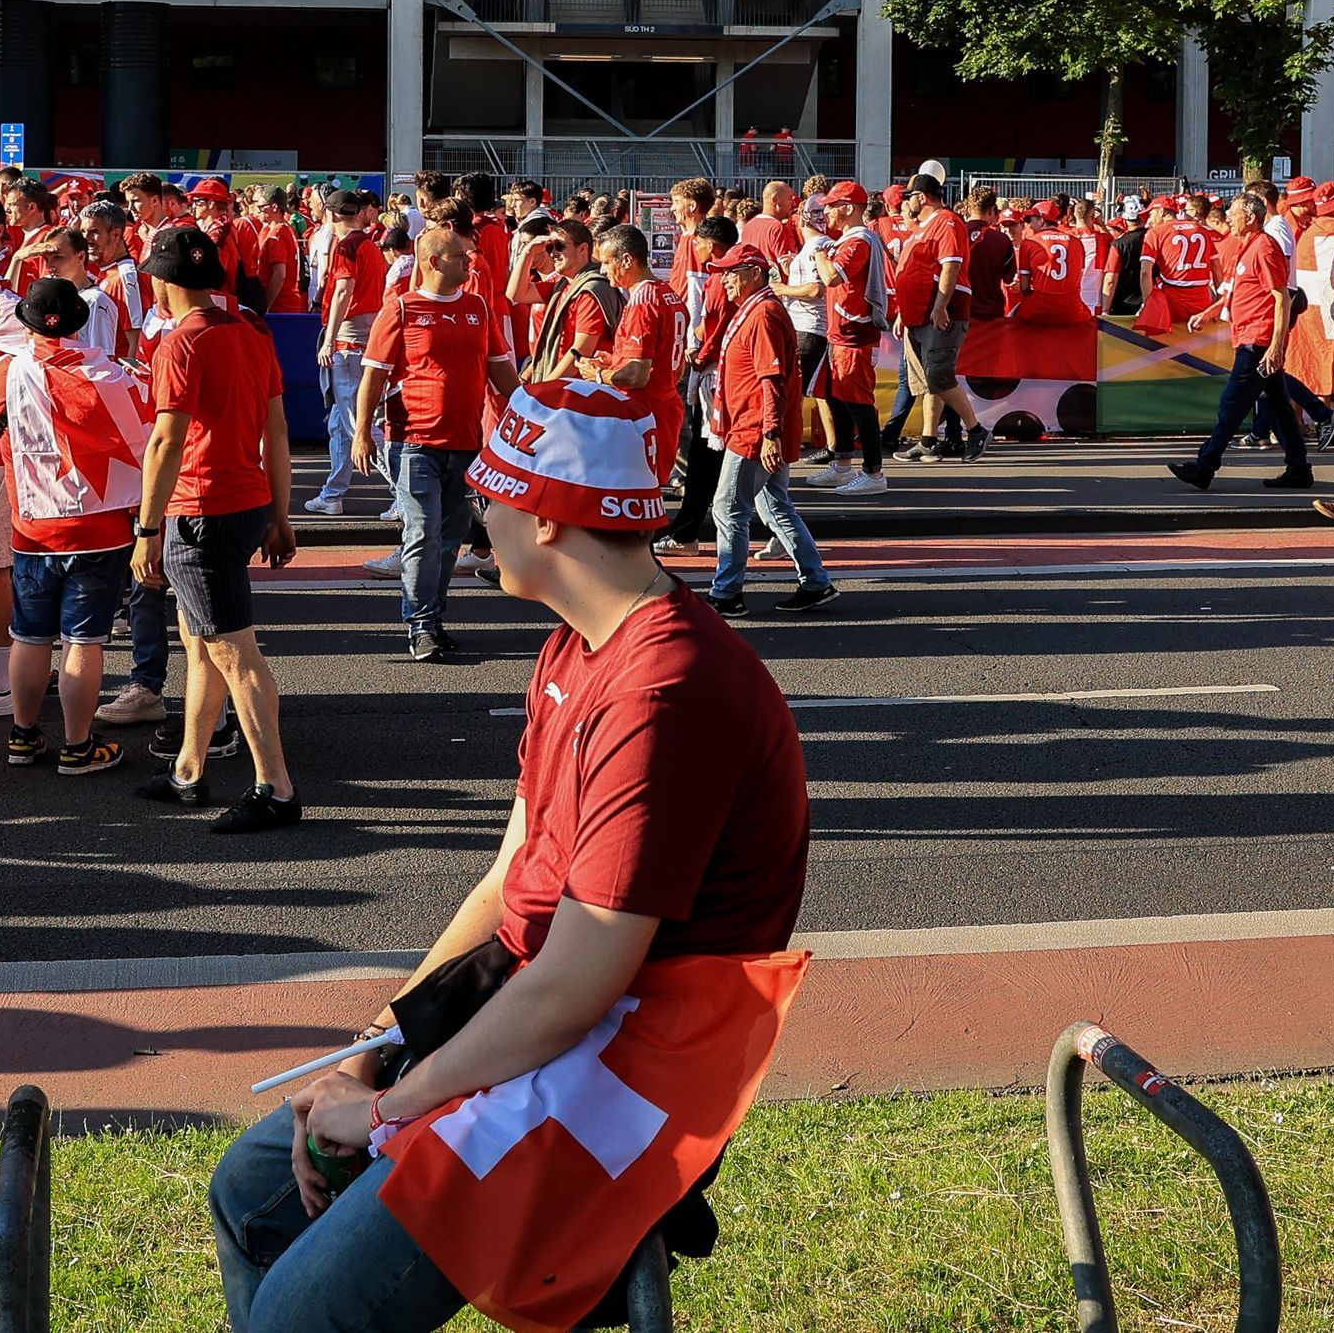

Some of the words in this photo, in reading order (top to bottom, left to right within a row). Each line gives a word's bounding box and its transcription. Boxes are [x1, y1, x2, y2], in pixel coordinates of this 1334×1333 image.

[624, 24, 639, 33] SÜD
[1050, 244, 1067, 280] 3
[1172, 233, 1207, 270] 22
[672, 311, 686, 370] 8
[479, 467, 529, 498] HOPP
